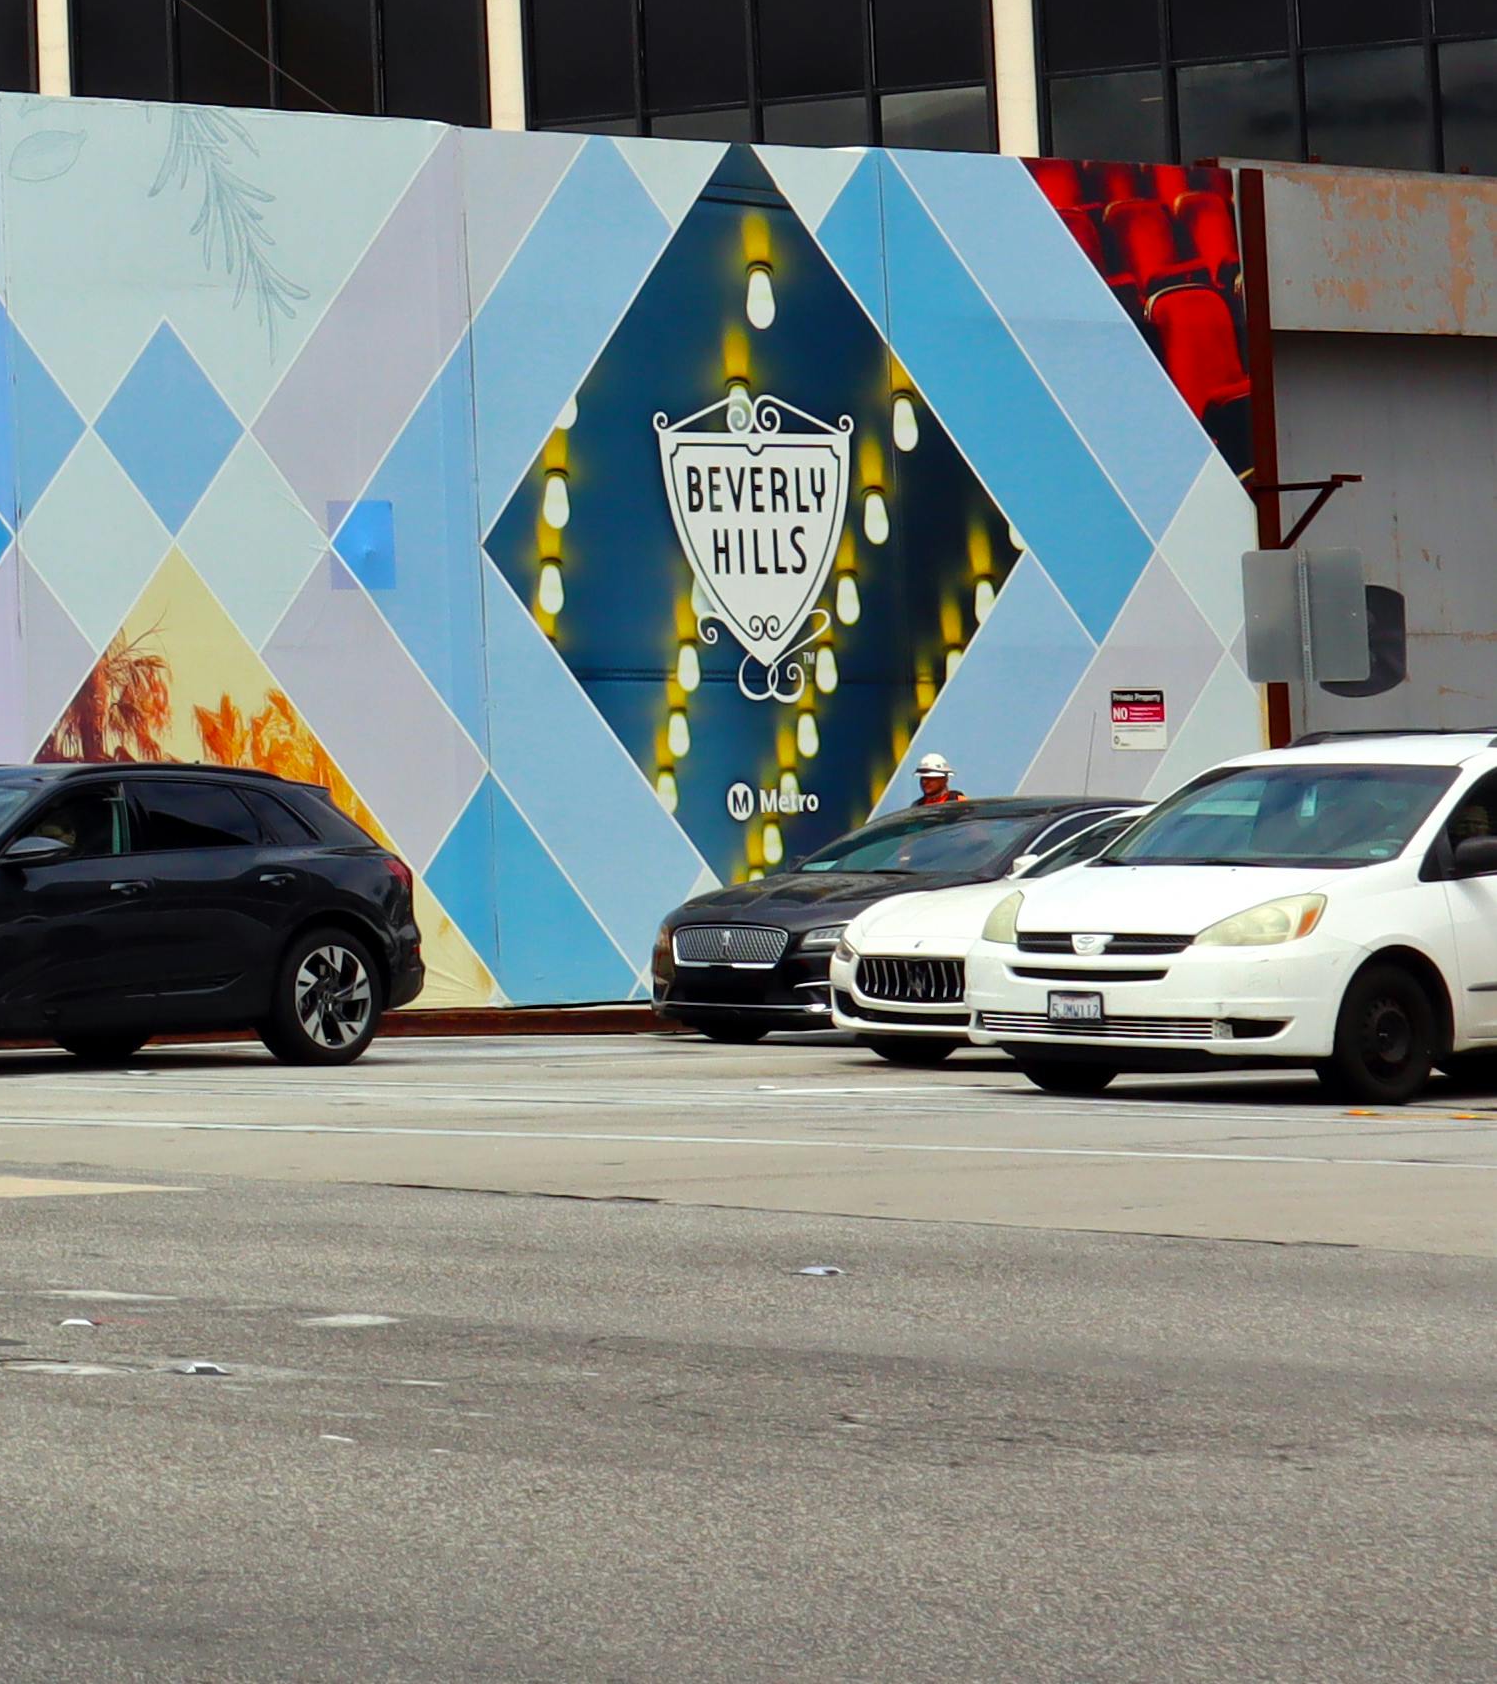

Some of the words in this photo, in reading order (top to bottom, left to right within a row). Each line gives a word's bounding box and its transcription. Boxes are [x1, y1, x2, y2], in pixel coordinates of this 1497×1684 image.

[686, 465, 826, 513] BEVERLY
[712, 525, 808, 575] HILLS
[1112, 706, 1128, 721] NO
[758, 788, 820, 814] Metro
